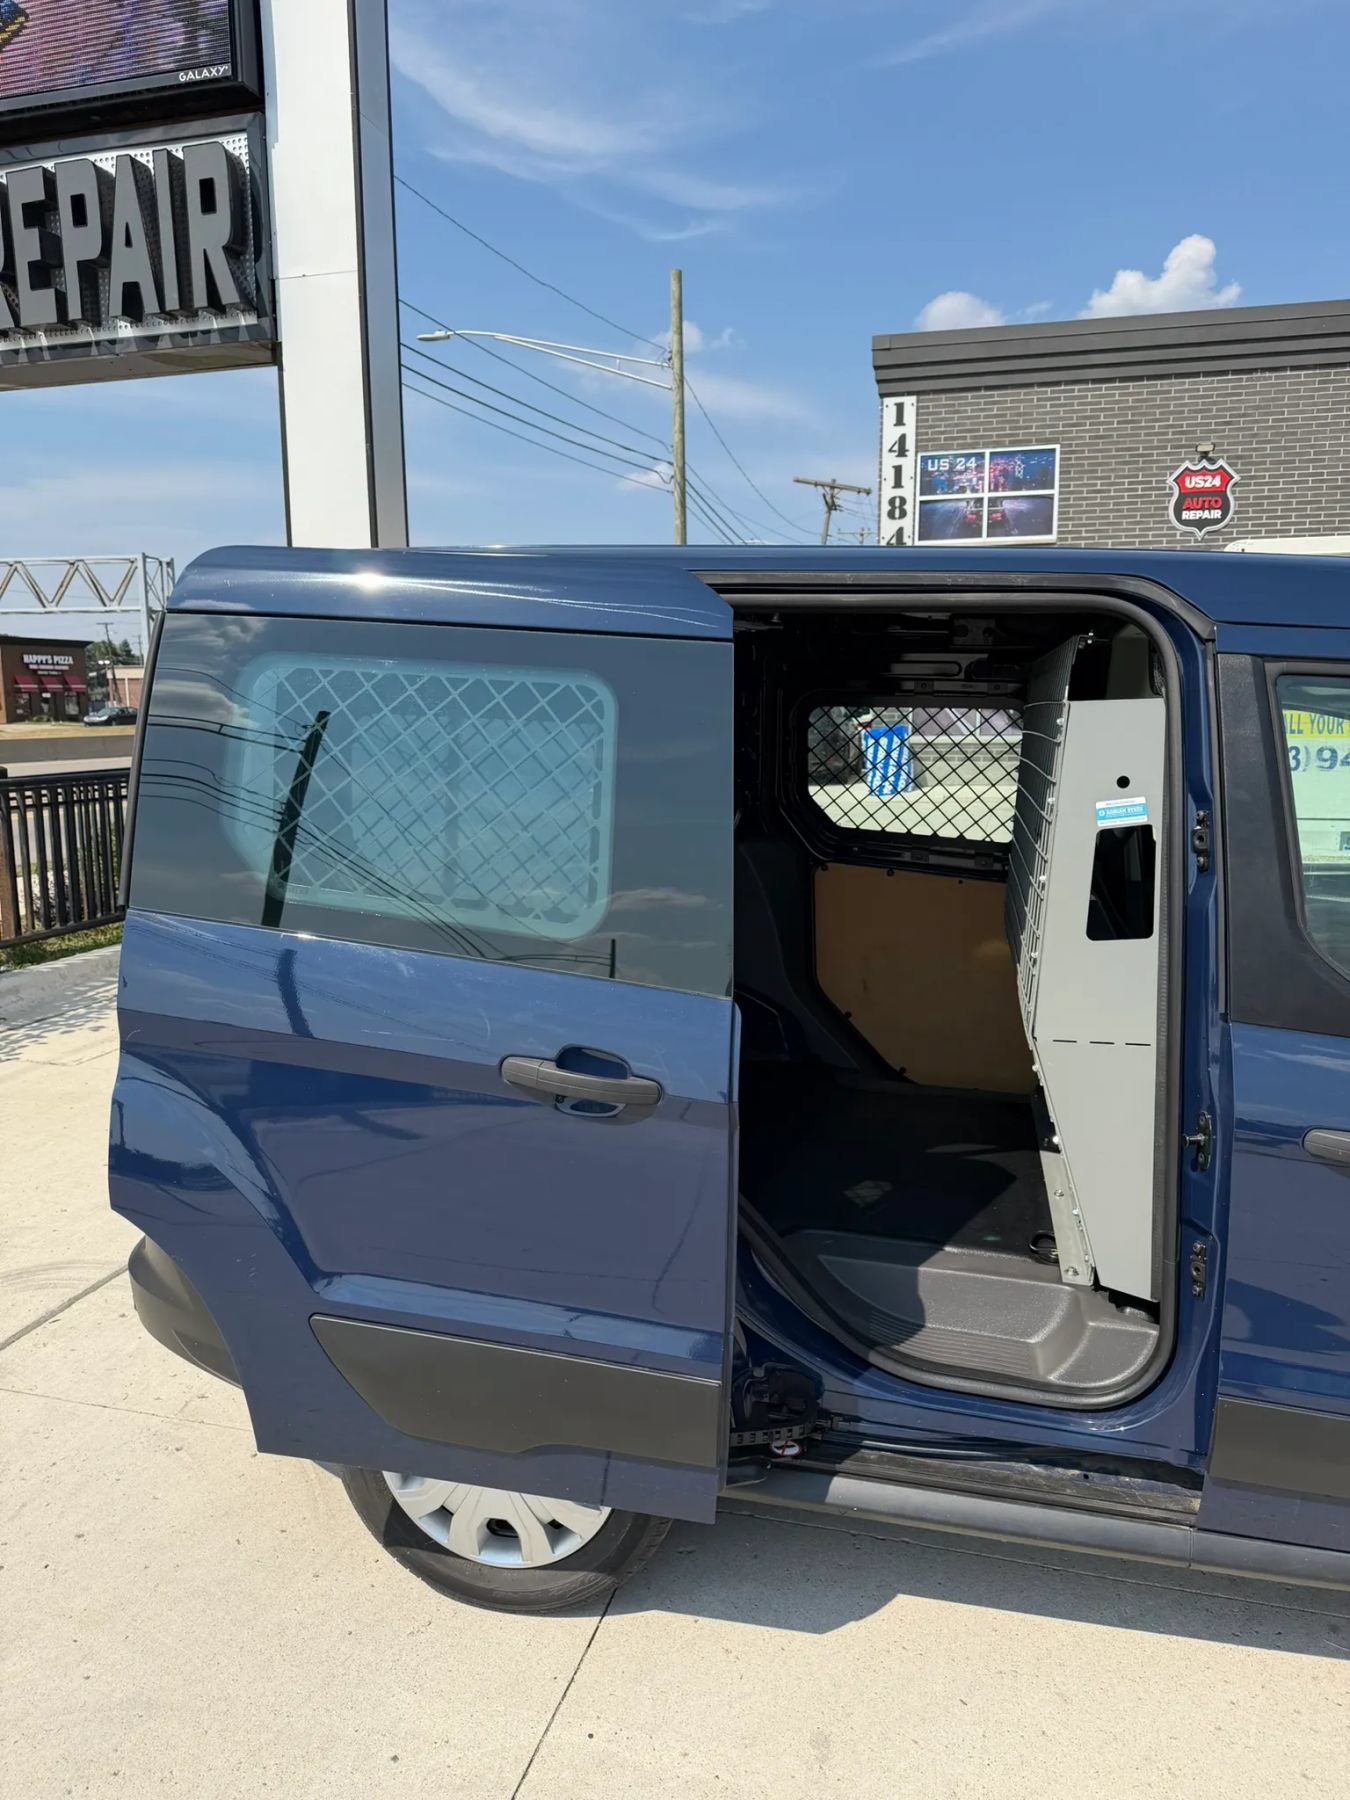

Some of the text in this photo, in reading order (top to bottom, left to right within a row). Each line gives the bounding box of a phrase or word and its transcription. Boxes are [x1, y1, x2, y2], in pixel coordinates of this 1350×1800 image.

[927, 456, 977, 471] US 24
[1184, 475, 1222, 488] US24
[1182, 496, 1222, 509] AUTO
[1181, 509, 1222, 520] REPAIR
[53, 655, 74, 665] PIZZA
[1309, 712, 1344, 735] YOUR
